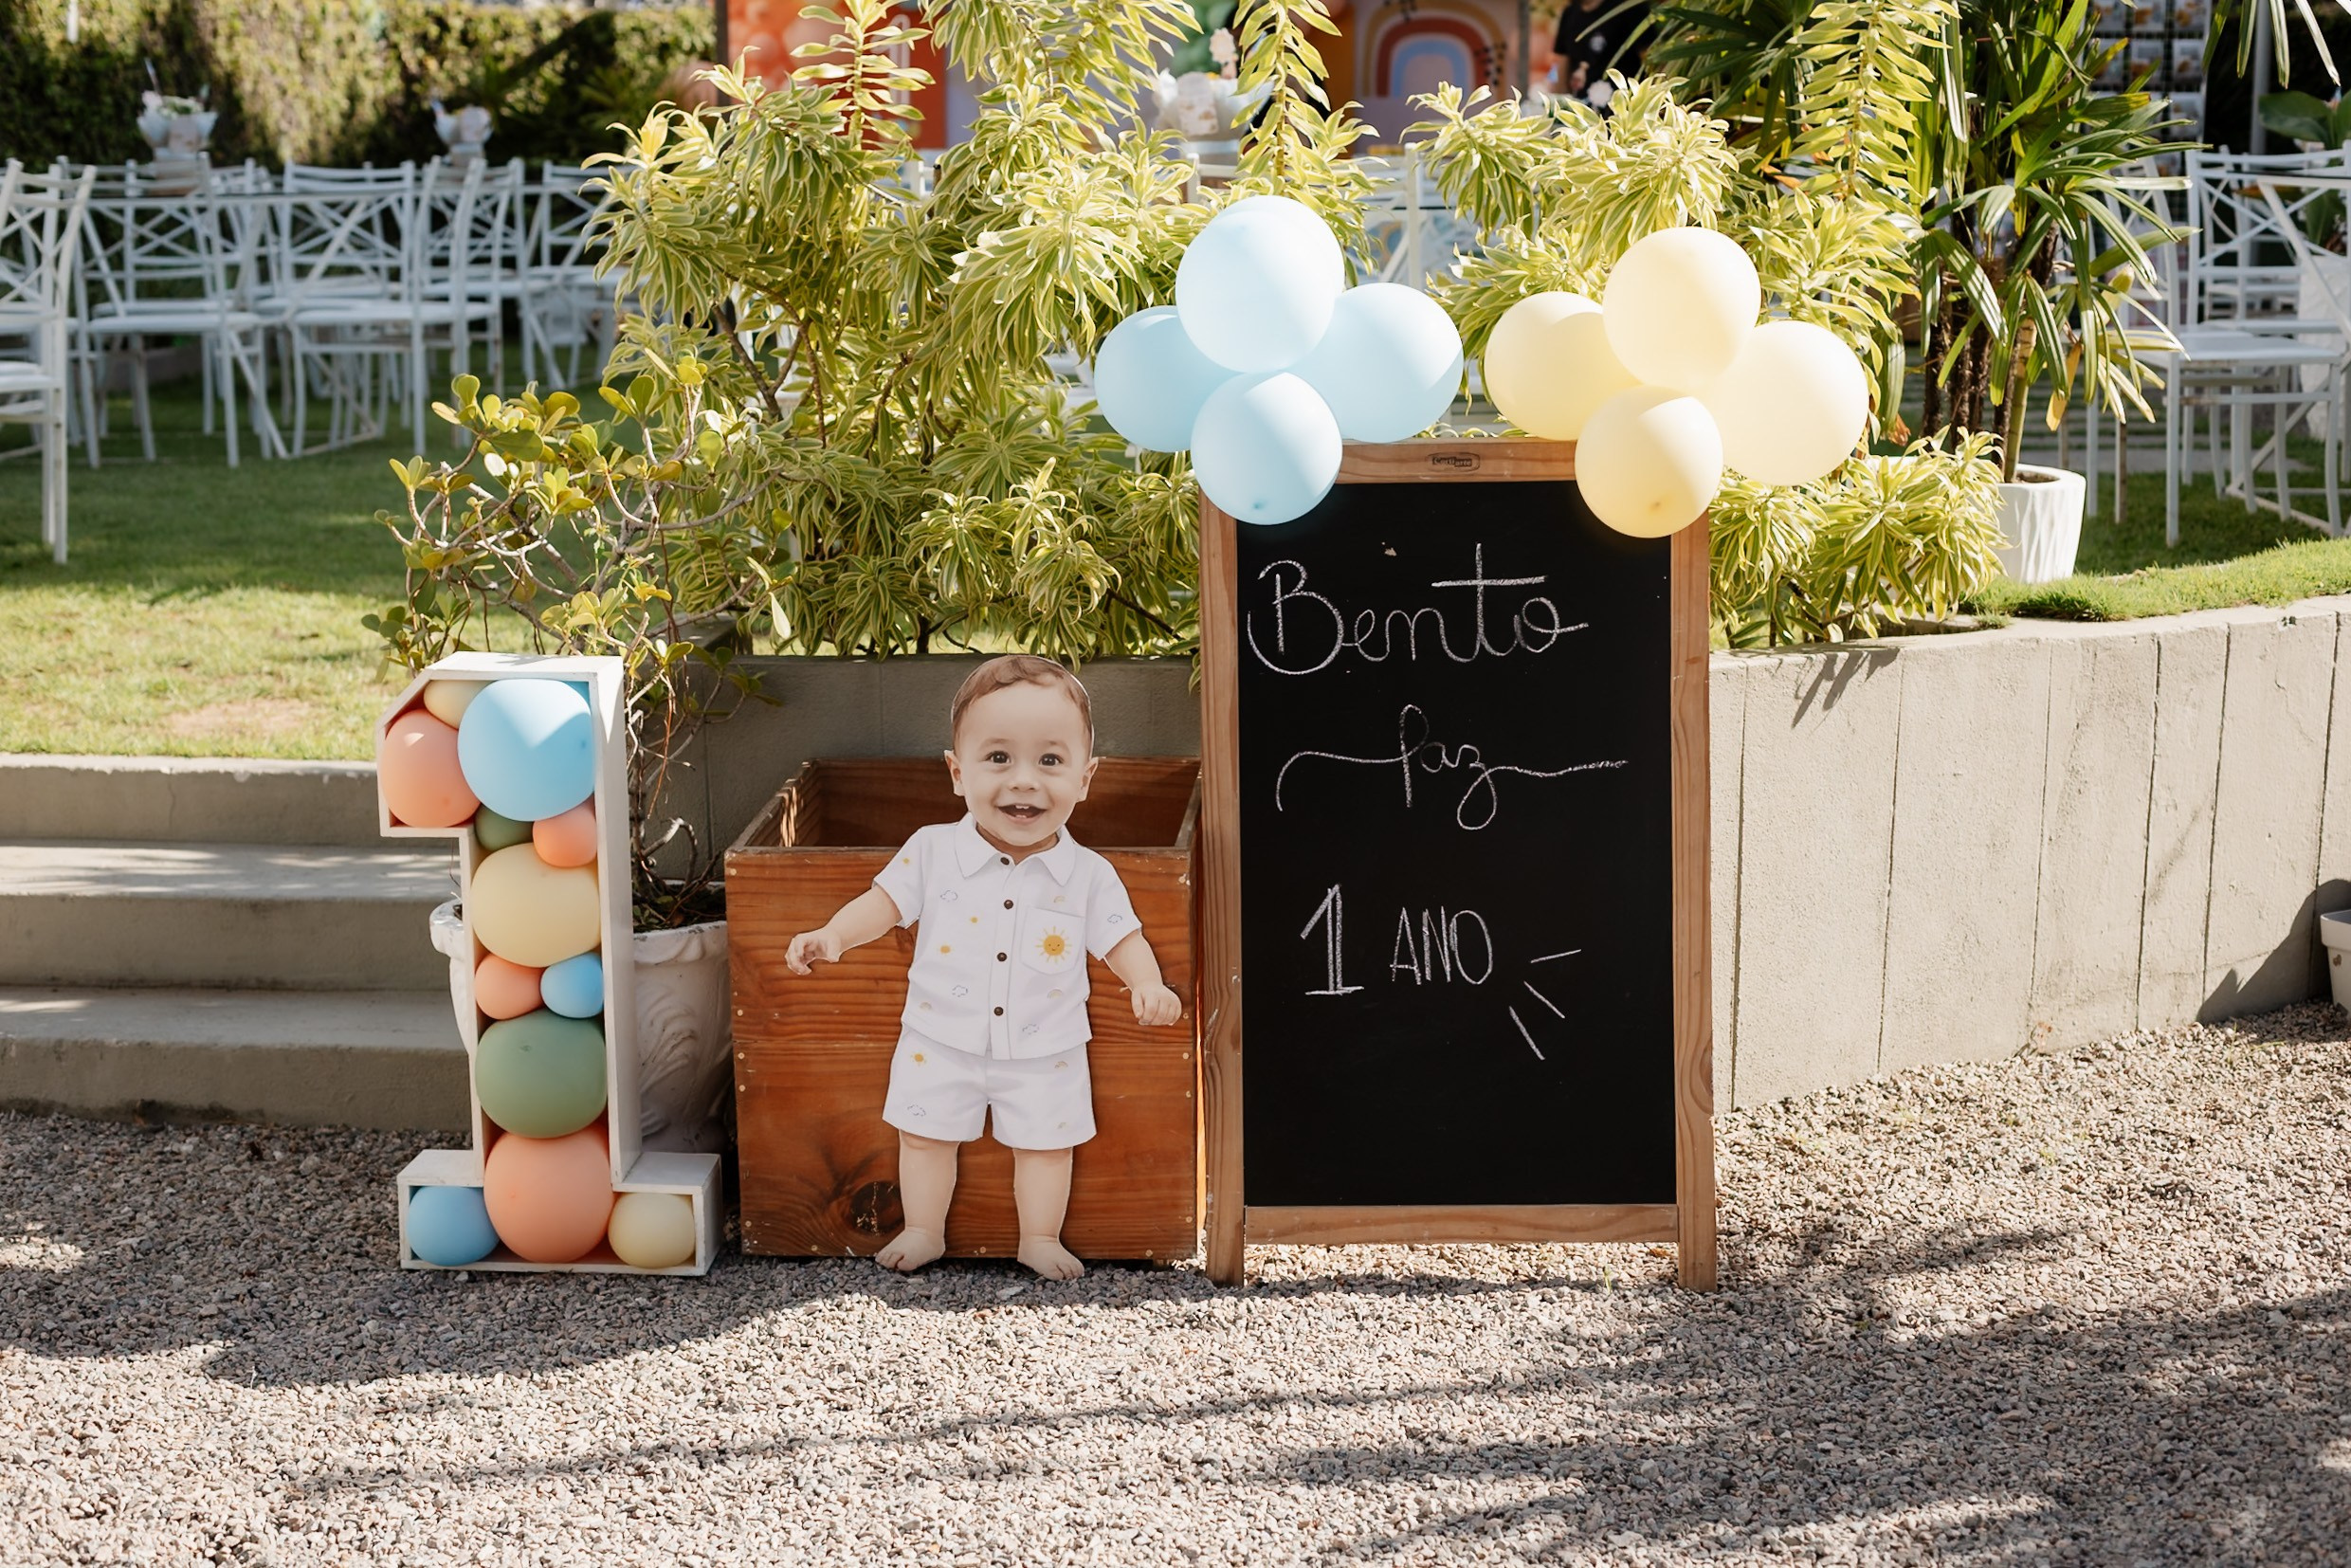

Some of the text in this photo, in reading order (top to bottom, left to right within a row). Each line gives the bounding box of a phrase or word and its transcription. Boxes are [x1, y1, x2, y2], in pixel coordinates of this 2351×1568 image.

[1247, 542, 1589, 675] Bento
[377, 651, 722, 1275] 1
[1300, 884, 1493, 995] 1 ANO
